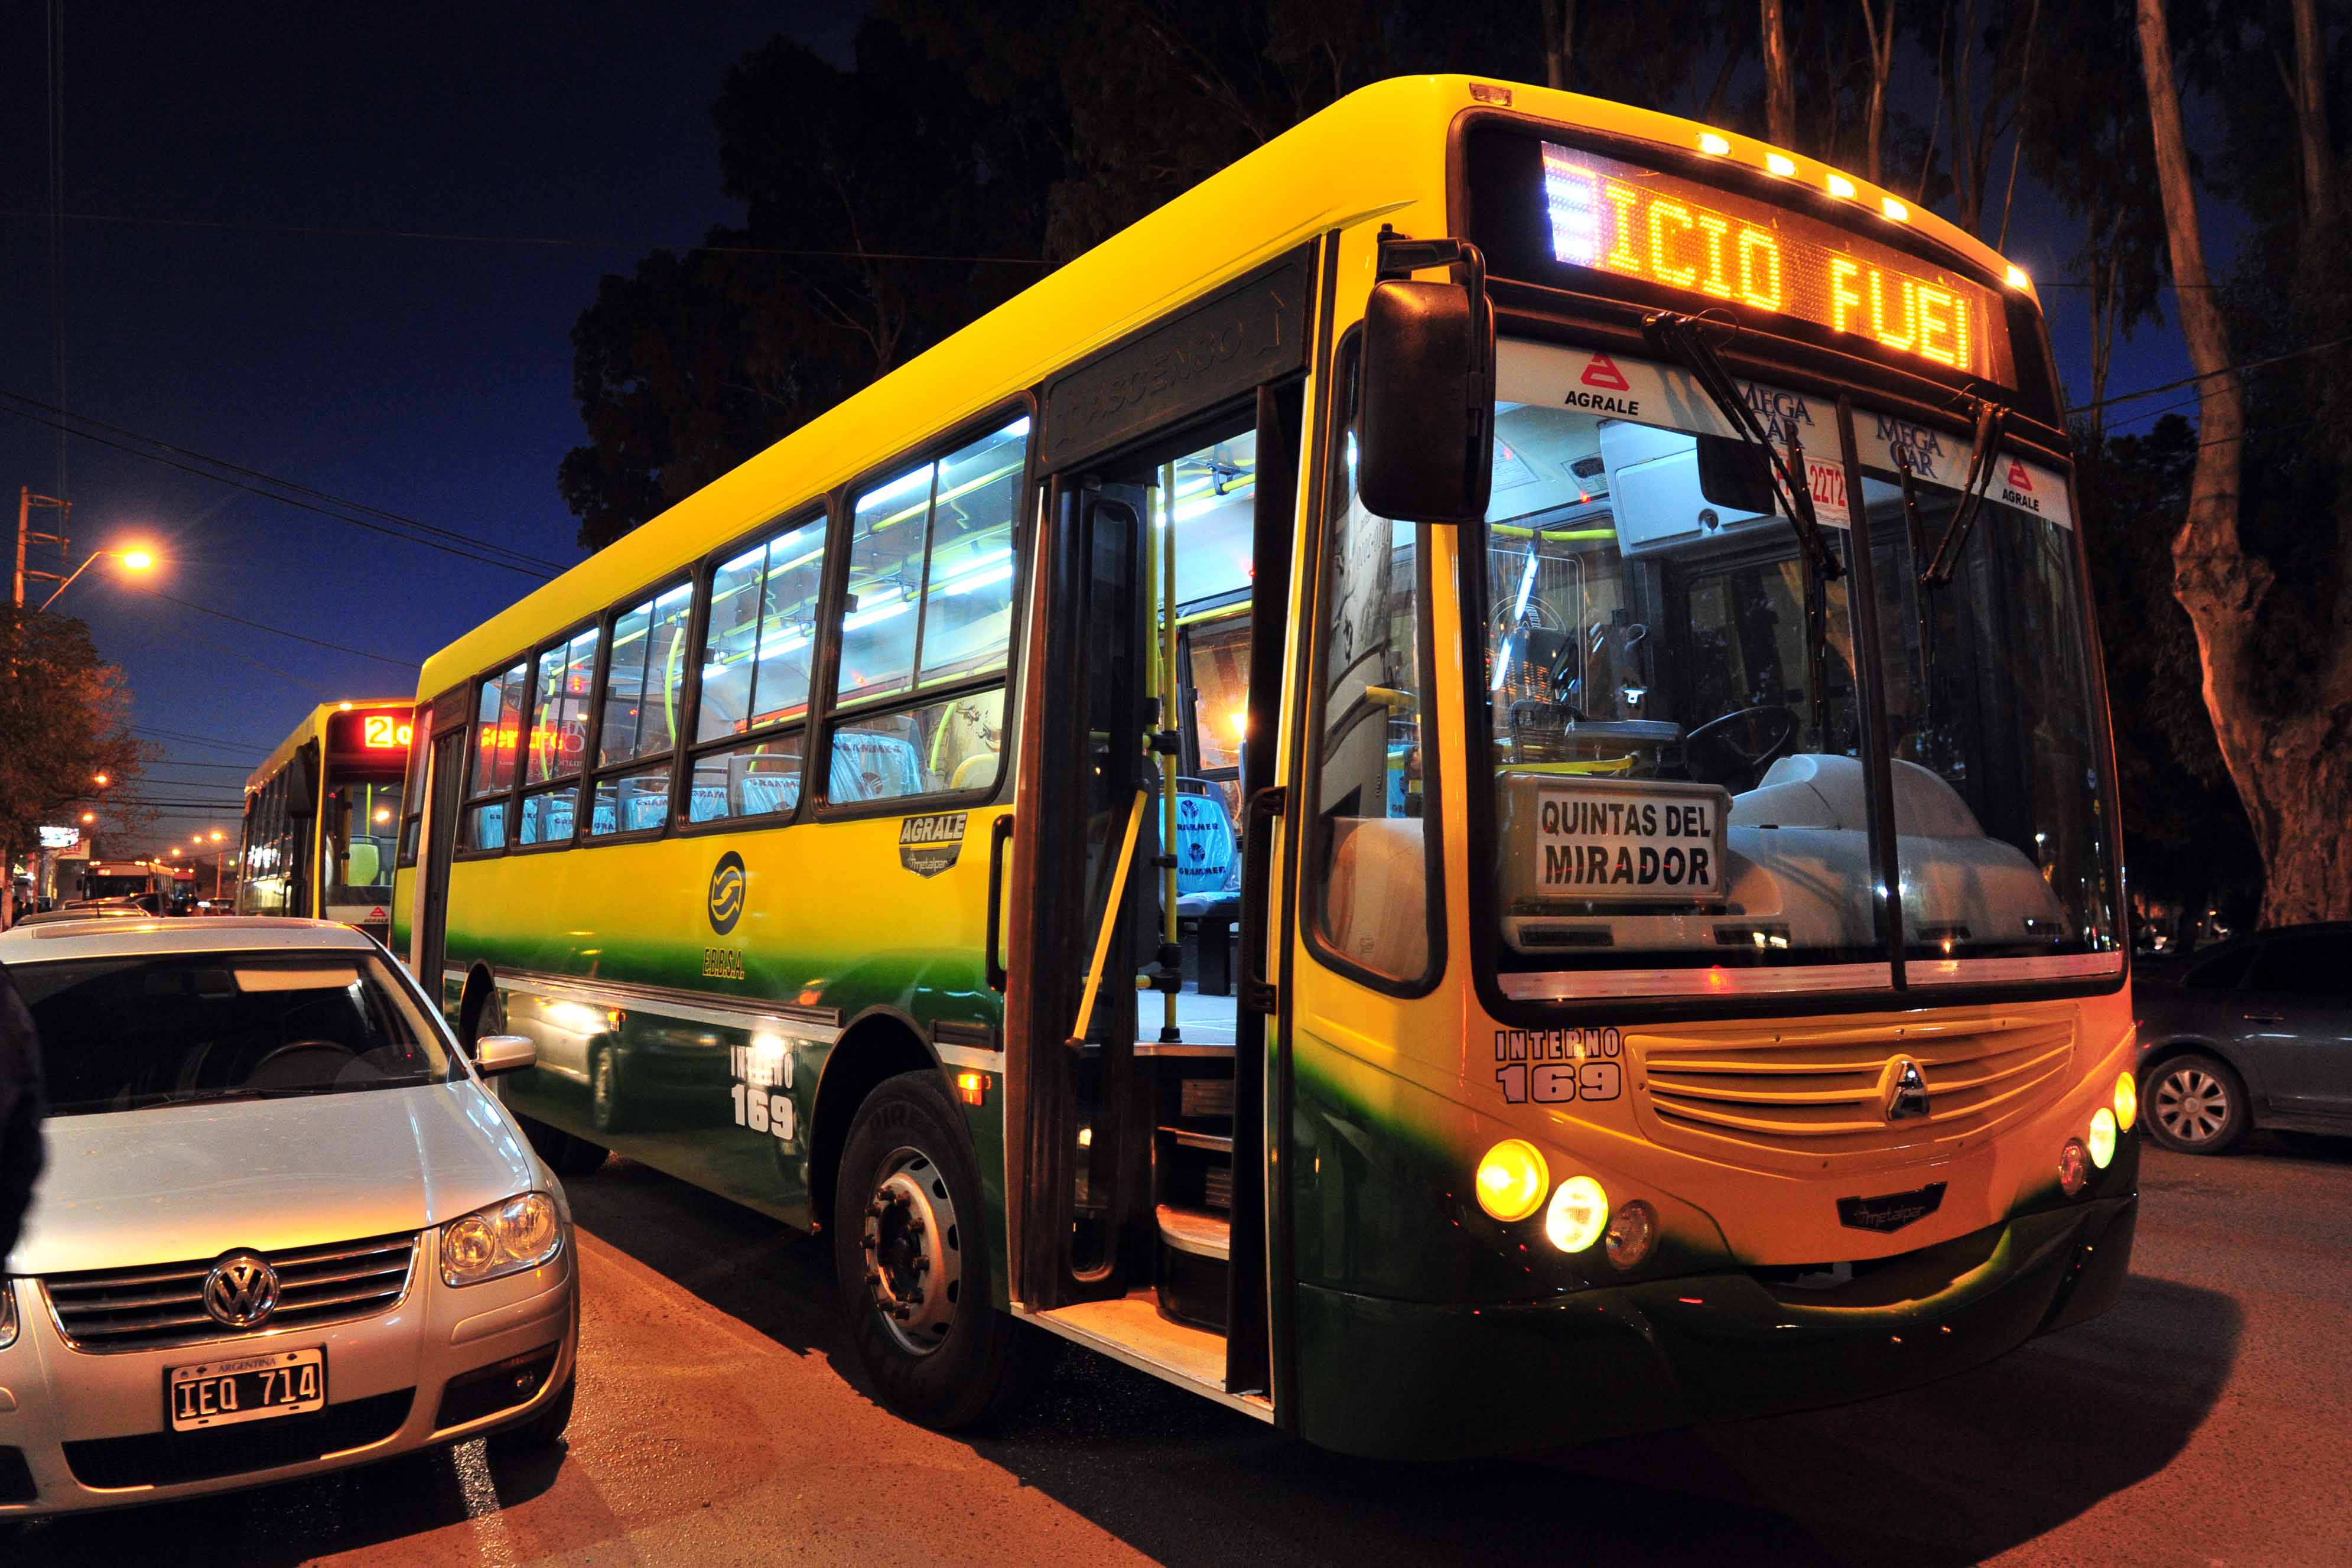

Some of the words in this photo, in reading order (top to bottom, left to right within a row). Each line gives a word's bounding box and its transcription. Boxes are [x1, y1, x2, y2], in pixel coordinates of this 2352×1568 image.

[1564, 391, 1639, 415] AGRALE
[1765, 412, 1806, 450] AR
[1876, 413, 1944, 458] MEGA
[1890, 440, 1938, 480] CAR
[2002, 489, 2039, 512] AGRALE
[900, 815, 967, 842] AGRALE
[1542, 800, 1657, 836] QUINTAS
[1665, 805, 1711, 838] DEL
[1545, 845, 1709, 885] MIRADOR
[1495, 1027, 1621, 1062] INTERNO
[1495, 1062, 1621, 1104] 169
[731, 1084, 793, 1141] 169
[218, 1358, 276, 1373] ARGENTINA
[179, 1377, 238, 1418] IEQ
[258, 1365, 316, 1405] 714
